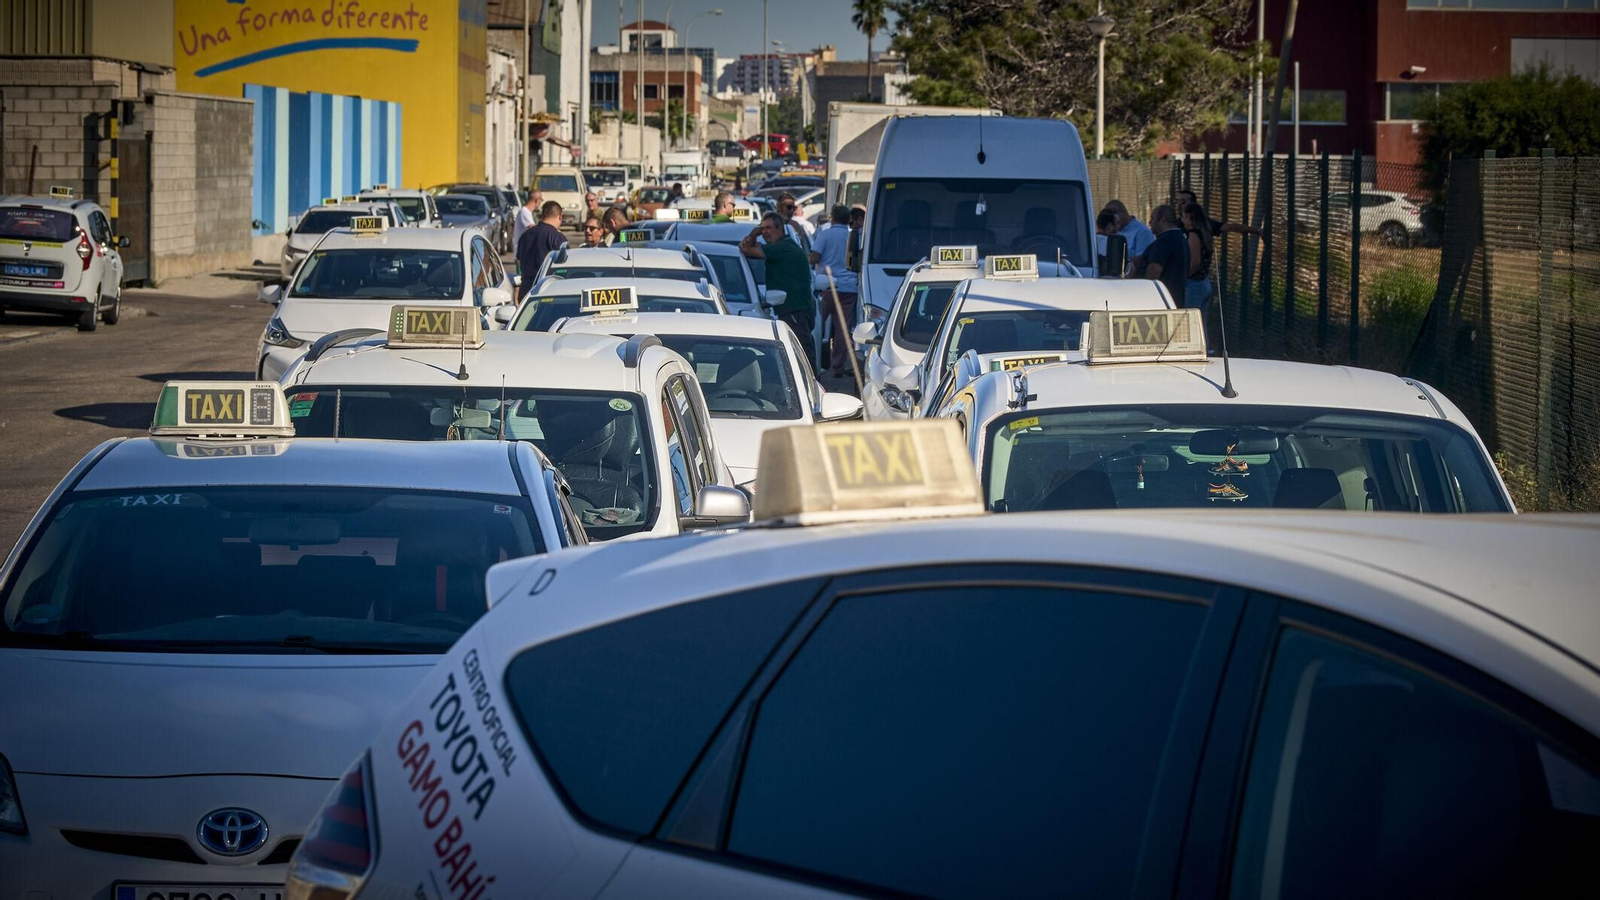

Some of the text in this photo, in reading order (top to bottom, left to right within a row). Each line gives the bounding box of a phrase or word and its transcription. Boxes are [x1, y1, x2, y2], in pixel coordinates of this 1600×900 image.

[178, 0, 429, 56] Una forma diferente
[358, 218, 375, 228] TAXI
[688, 210, 704, 219] TAXI
[628, 231, 645, 241] TAXI
[941, 249, 963, 260] TAXI
[995, 258, 1021, 271] TAXI
[592, 289, 621, 305] TAXI
[408, 311, 450, 333] TAXI
[1113, 316, 1167, 343] TAXI
[187, 393, 243, 420] TAXI
[827, 432, 923, 485] TAXI
[120, 493, 183, 507] TAXI
[462, 648, 518, 778] CENTRO OFICIAL
[429, 672, 496, 821] TOYOTA
[397, 719, 452, 830] GAMO
